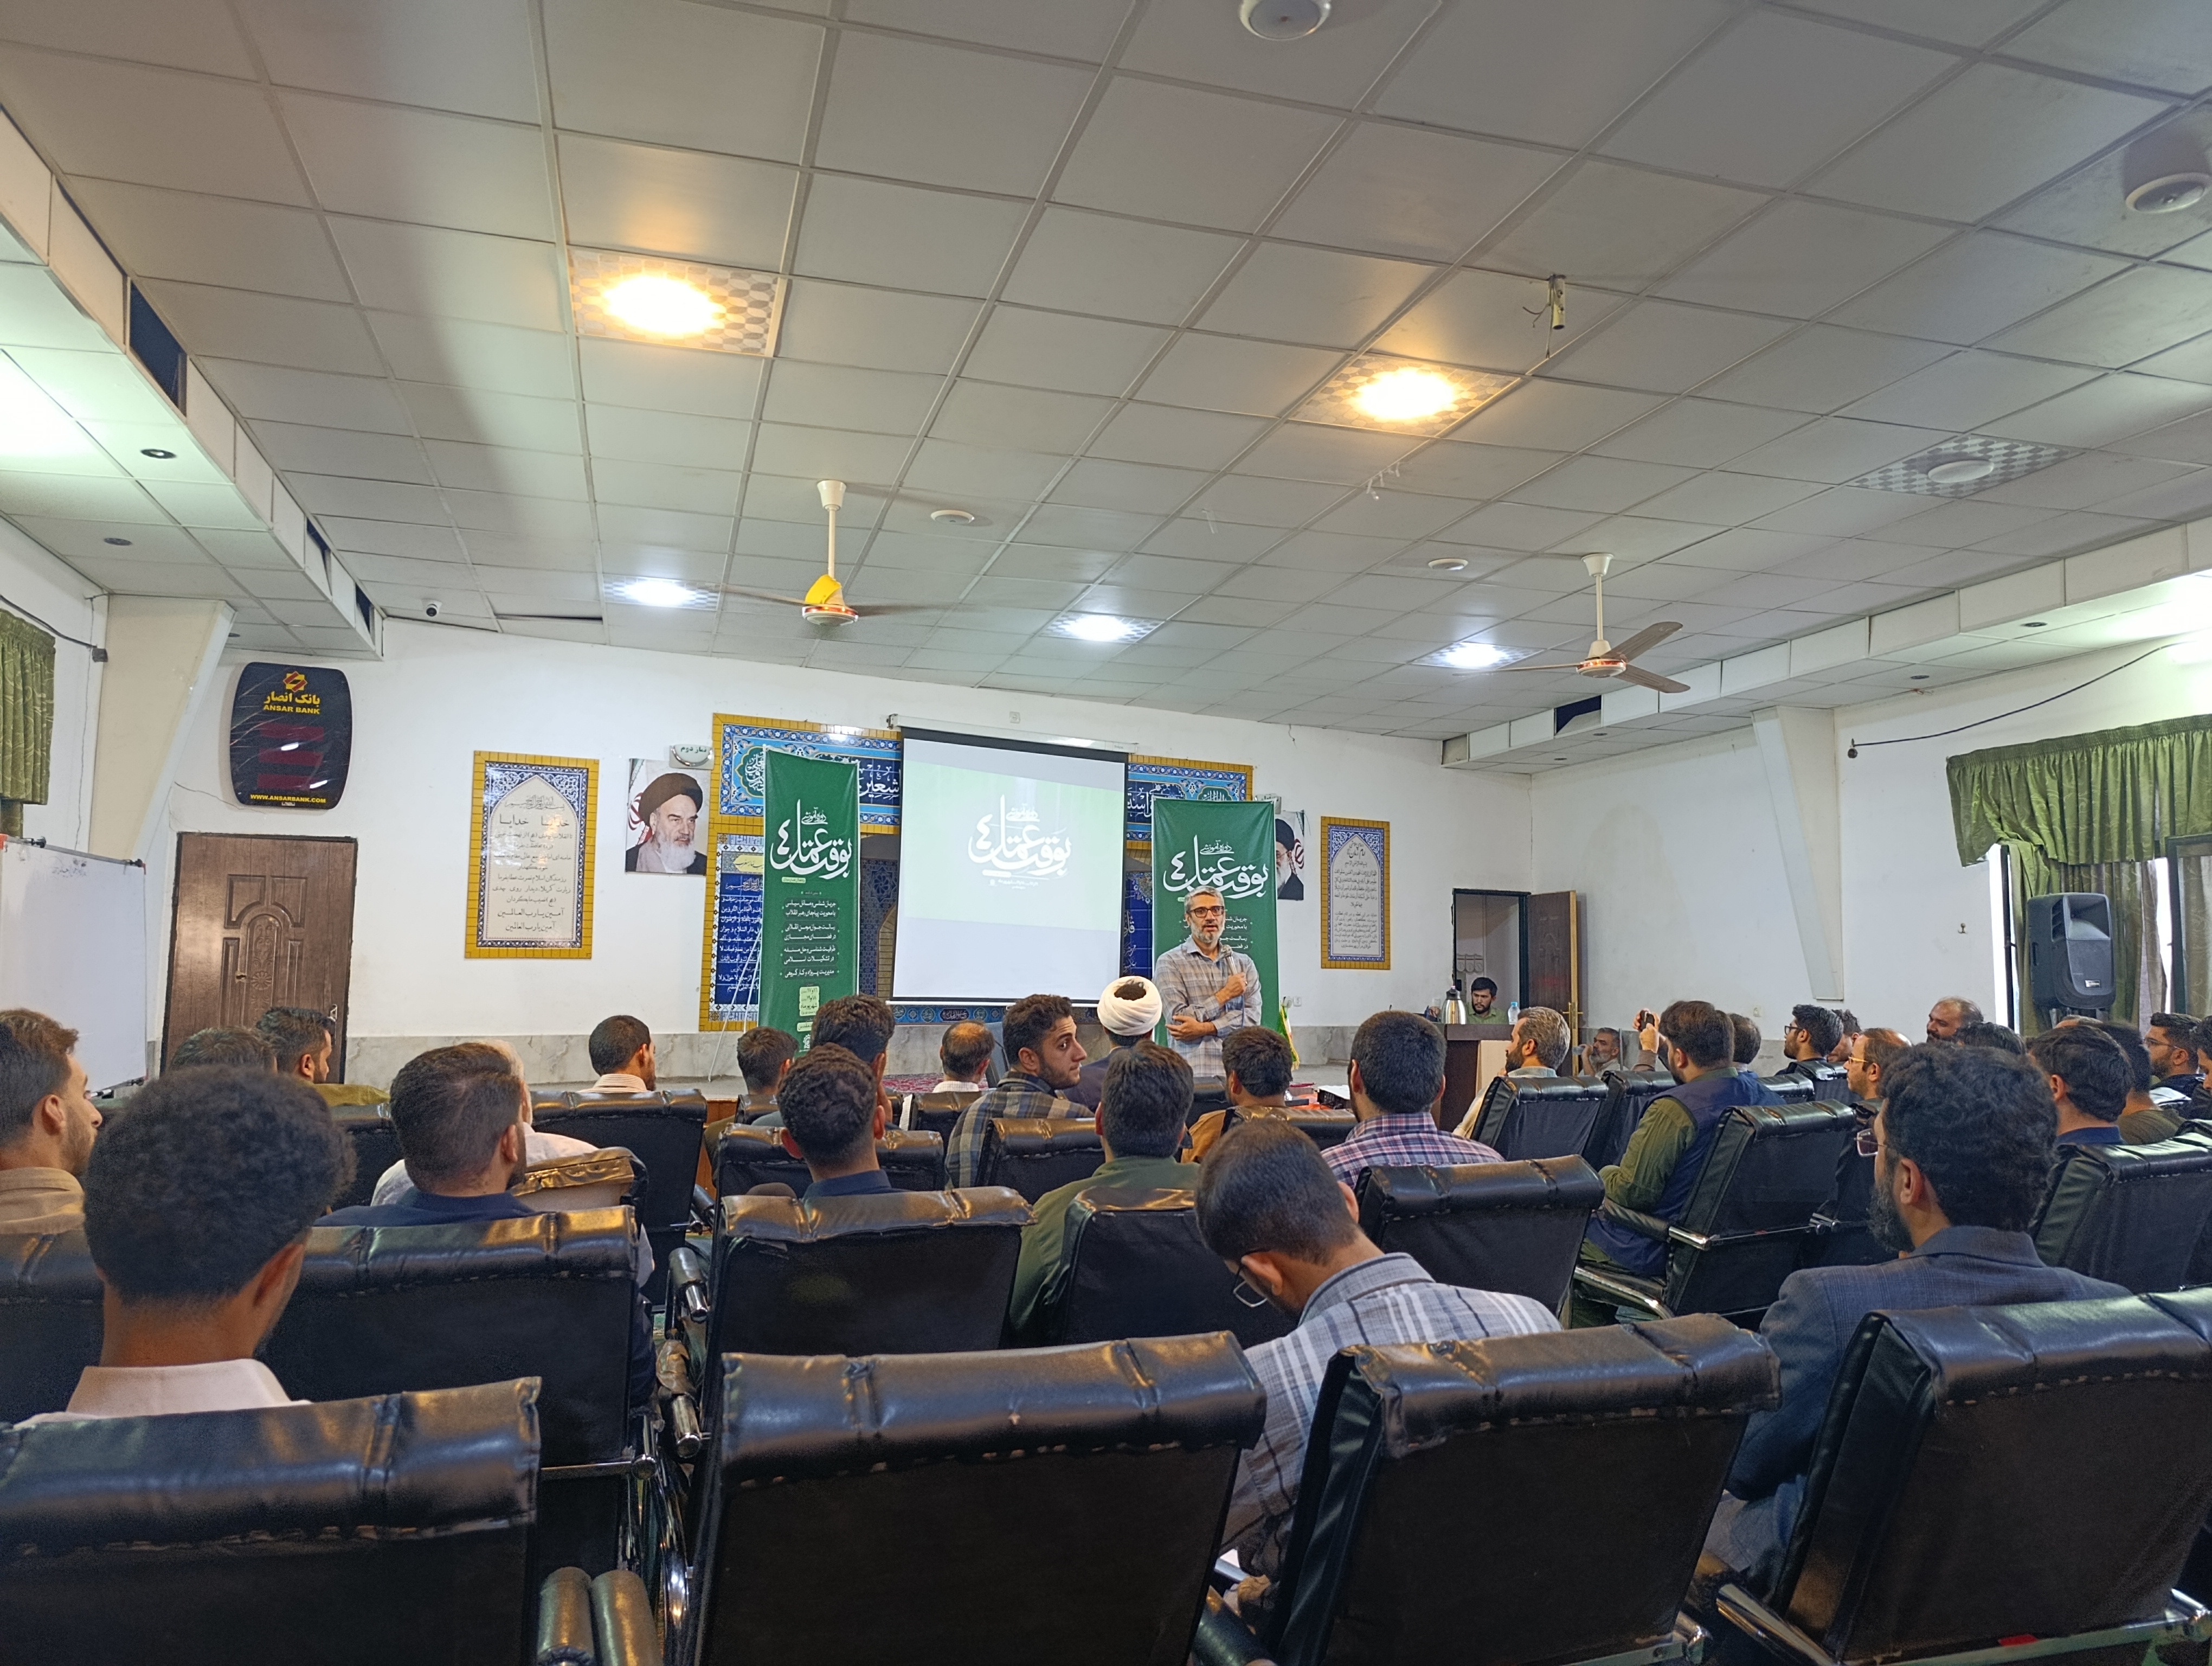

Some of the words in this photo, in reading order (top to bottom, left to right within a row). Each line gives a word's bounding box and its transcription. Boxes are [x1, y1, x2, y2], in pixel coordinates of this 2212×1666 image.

[263, 691, 293, 704] انصار
[295, 694, 320, 707] بانک
[250, 794, 326, 803] WWW.ANSARBANK.COM
[499, 813, 529, 828] خدایا
